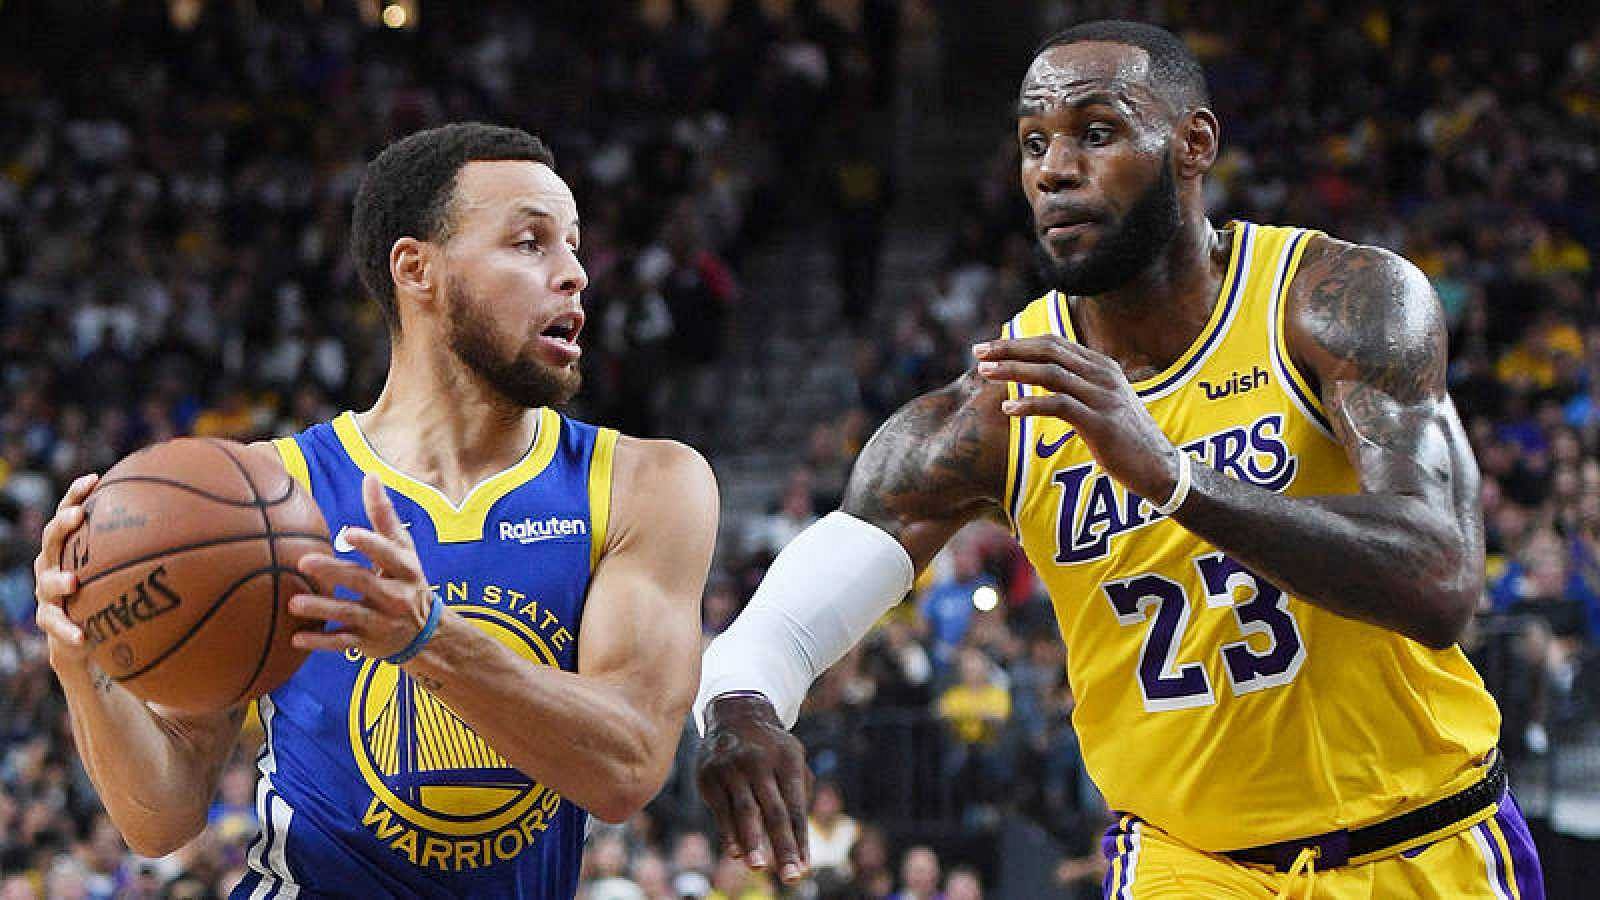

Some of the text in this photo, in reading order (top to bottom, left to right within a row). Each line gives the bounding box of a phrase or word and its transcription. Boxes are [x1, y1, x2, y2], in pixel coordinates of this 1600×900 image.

[1199, 366, 1270, 400] wish
[1052, 411, 1298, 565] LARS
[498, 515, 587, 545] Rakuten
[482, 584, 575, 652] STATE
[1100, 550, 1308, 713] 23
[362, 787, 561, 872] WARRIORS
